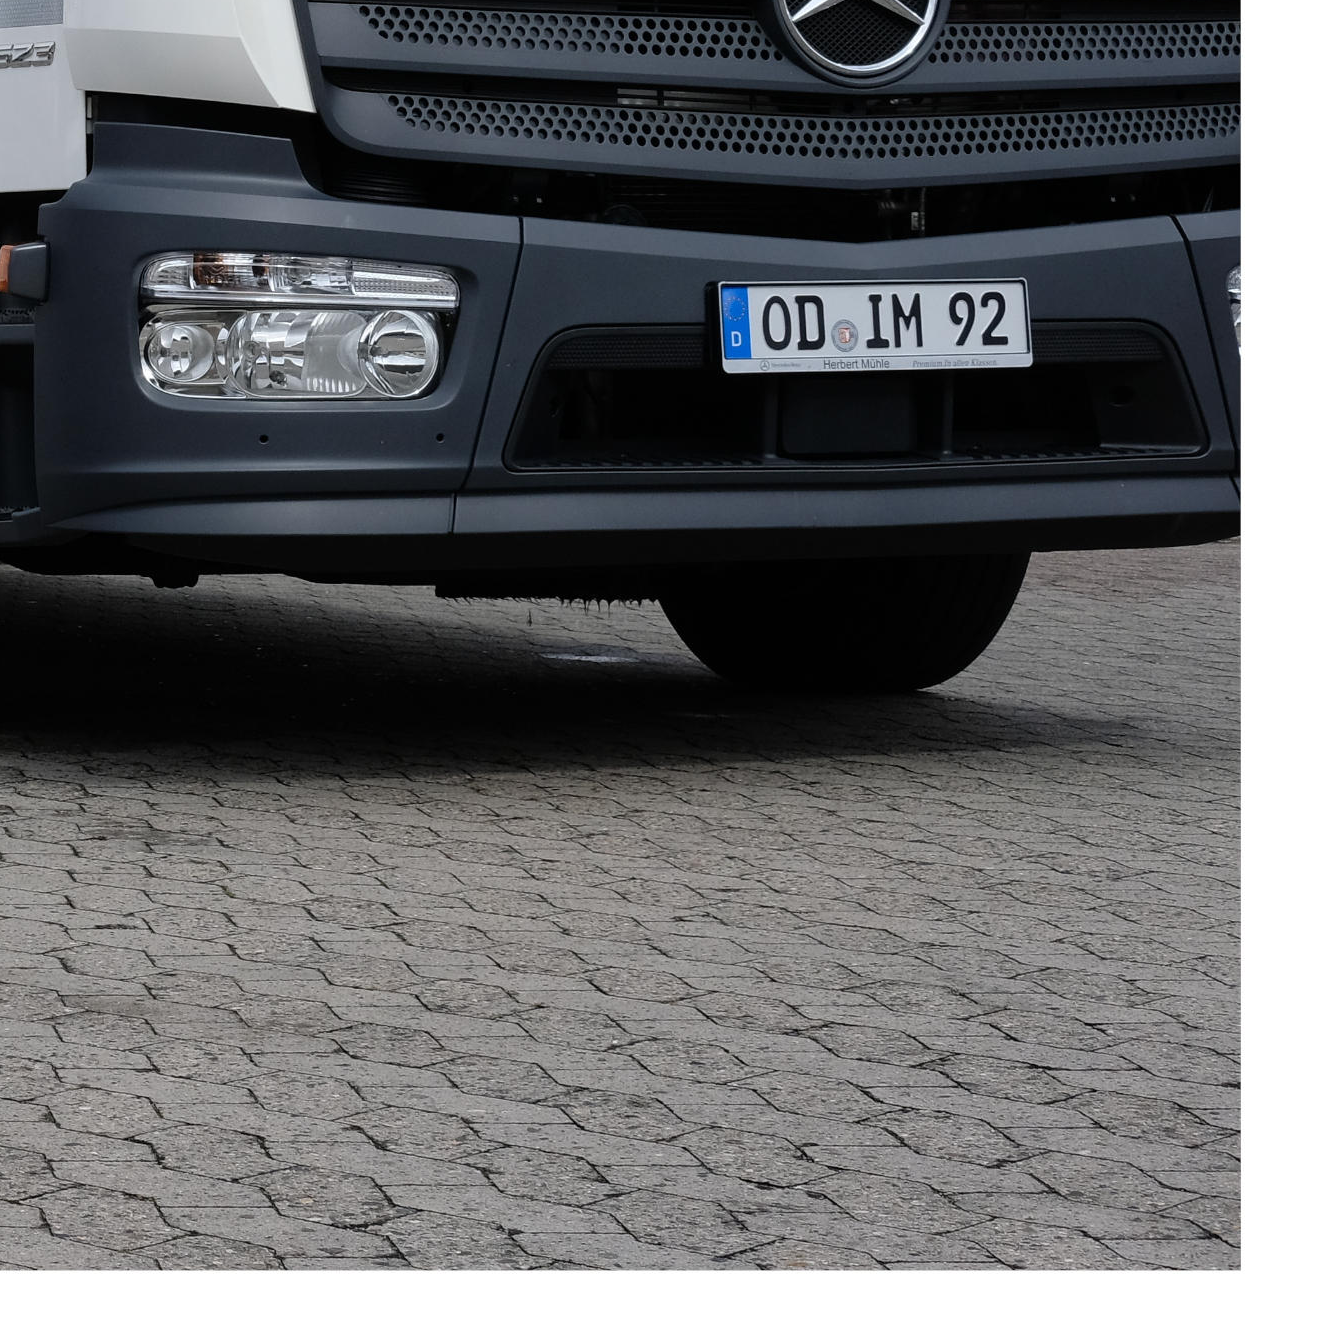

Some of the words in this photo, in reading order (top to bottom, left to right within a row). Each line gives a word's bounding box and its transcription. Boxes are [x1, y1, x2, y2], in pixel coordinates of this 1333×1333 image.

[762, 295, 826, 351] OD
[866, 293, 923, 349] IM
[948, 291, 1009, 346] 92
[731, 331, 742, 347] D
[823, 359, 858, 370] Herbert
[861, 358, 890, 369] Mühle
